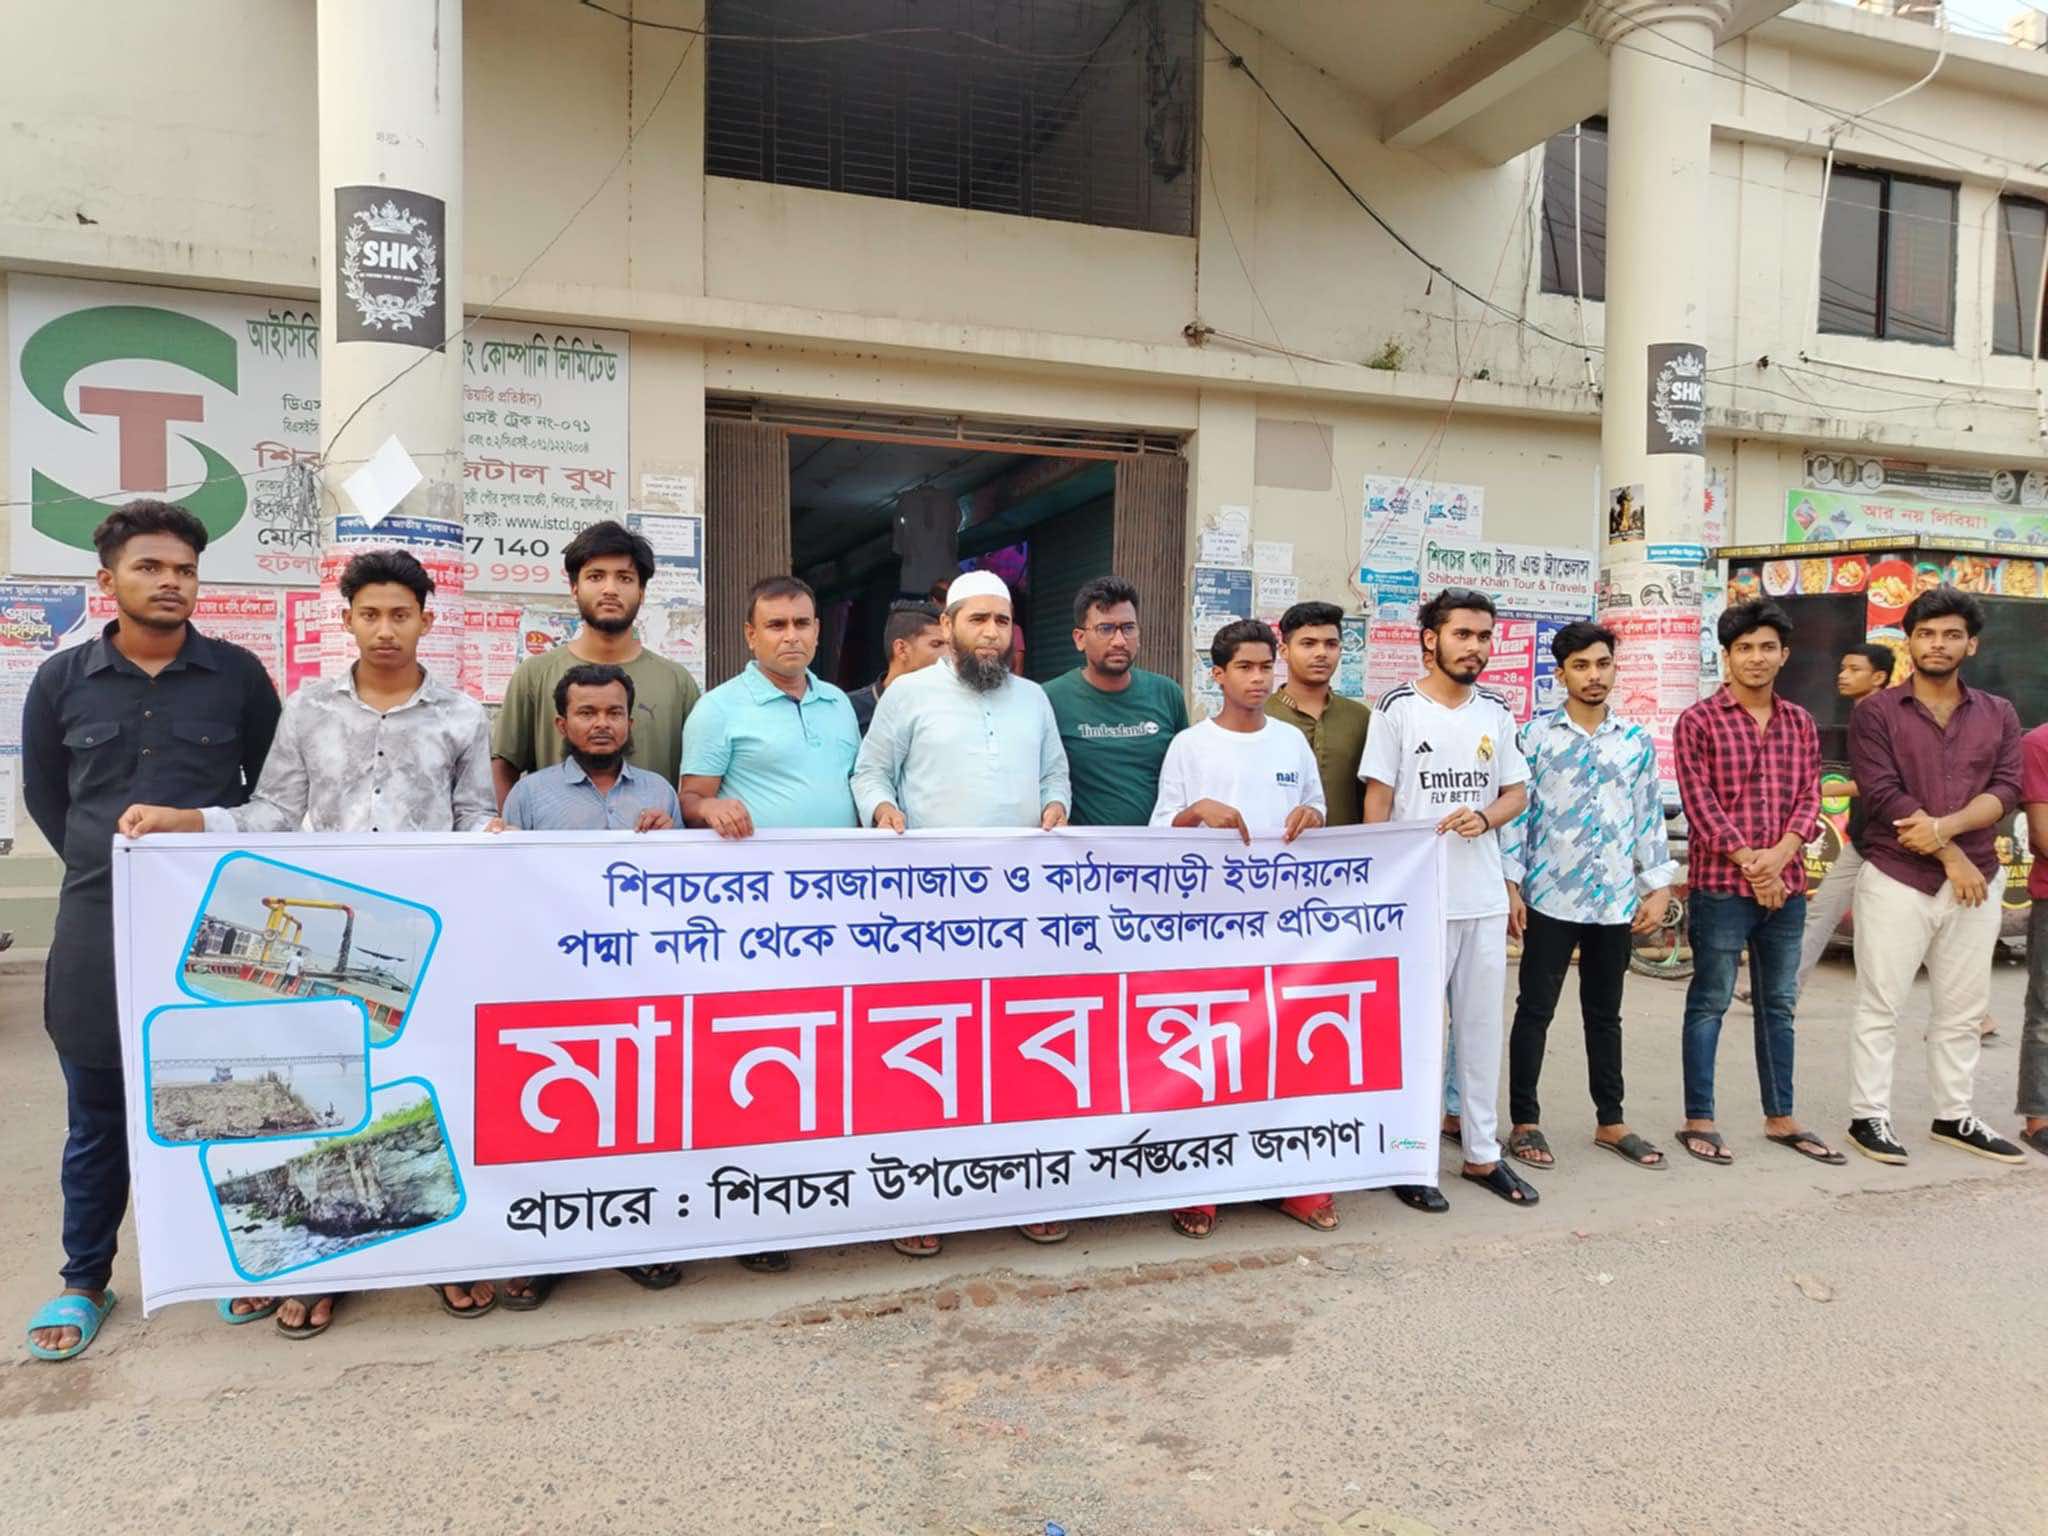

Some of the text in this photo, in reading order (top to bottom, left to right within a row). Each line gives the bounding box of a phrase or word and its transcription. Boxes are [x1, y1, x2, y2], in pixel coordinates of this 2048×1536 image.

[362, 240, 418, 271] SHK
[481, 333, 549, 378] কোম্পানি
[553, 336, 618, 382] লিমিটেড
[1671, 382, 1702, 402] SHK
[559, 466, 616, 494] বুথ
[494, 537, 549, 557] 140
[1427, 540, 1466, 571] শিবচর
[1470, 550, 1492, 574] খান
[1427, 571, 1477, 586] Shibchar
[1480, 576, 1509, 588] Khan
[1513, 577, 1536, 590] Tour
[1538, 580, 1546, 591] &
[1549, 580, 1588, 594] Travels
[1419, 767, 1489, 790] Emirates
[1431, 791, 1448, 805] FLY
[603, 852, 1373, 908] শিবচরের চরজানাজাত ও কাঠালবাড়ী ইউনিয়নের
[558, 897, 1408, 968] পদ্মা নদী থেকে অবৈধভাবে বালু উত্তোলনের প্রতিবাদে
[507, 1187, 658, 1238] প্রচারে
[707, 1165, 856, 1220] শিবচর
[867, 1152, 1077, 1199] উপজেলার
[1087, 1128, 1239, 1180] সর্বস্তরের
[1249, 1118, 1365, 1163] জনগণ
